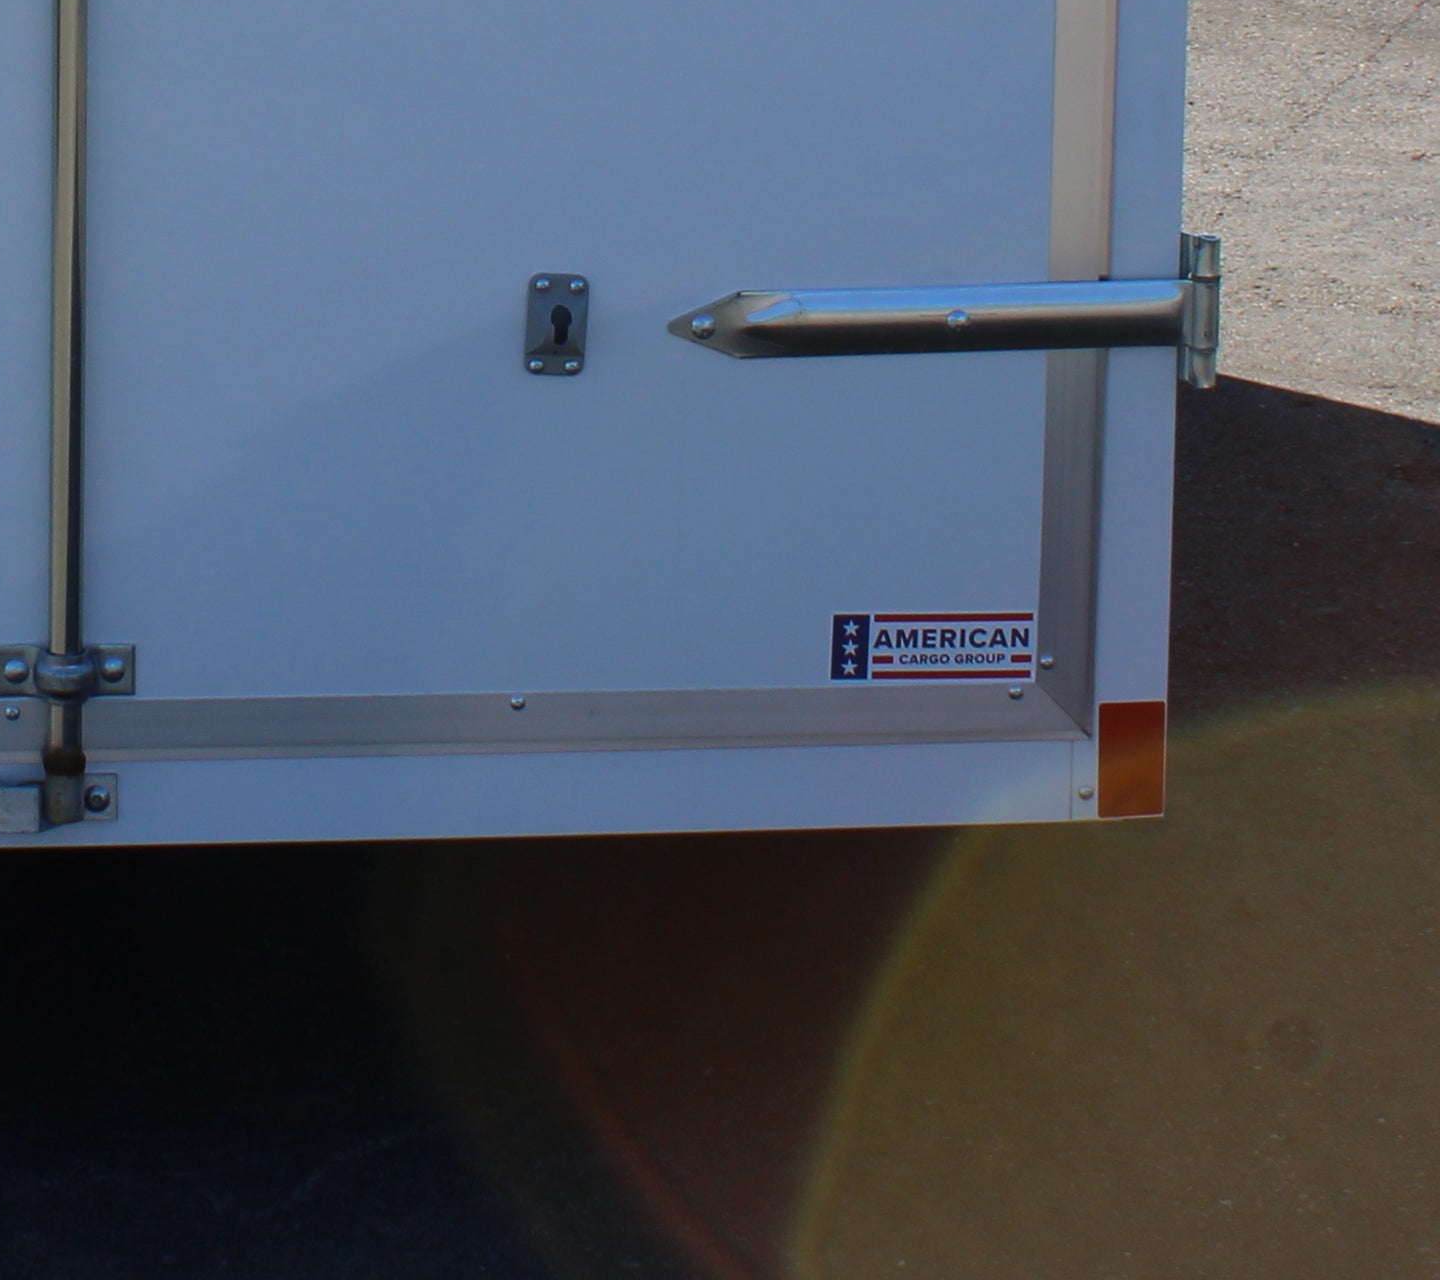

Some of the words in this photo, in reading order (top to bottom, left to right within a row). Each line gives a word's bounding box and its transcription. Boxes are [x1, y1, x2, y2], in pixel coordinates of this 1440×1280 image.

[873, 627, 1030, 649] AMERICAN
[898, 653, 950, 666] CARGO
[954, 653, 1006, 665] GROUP
